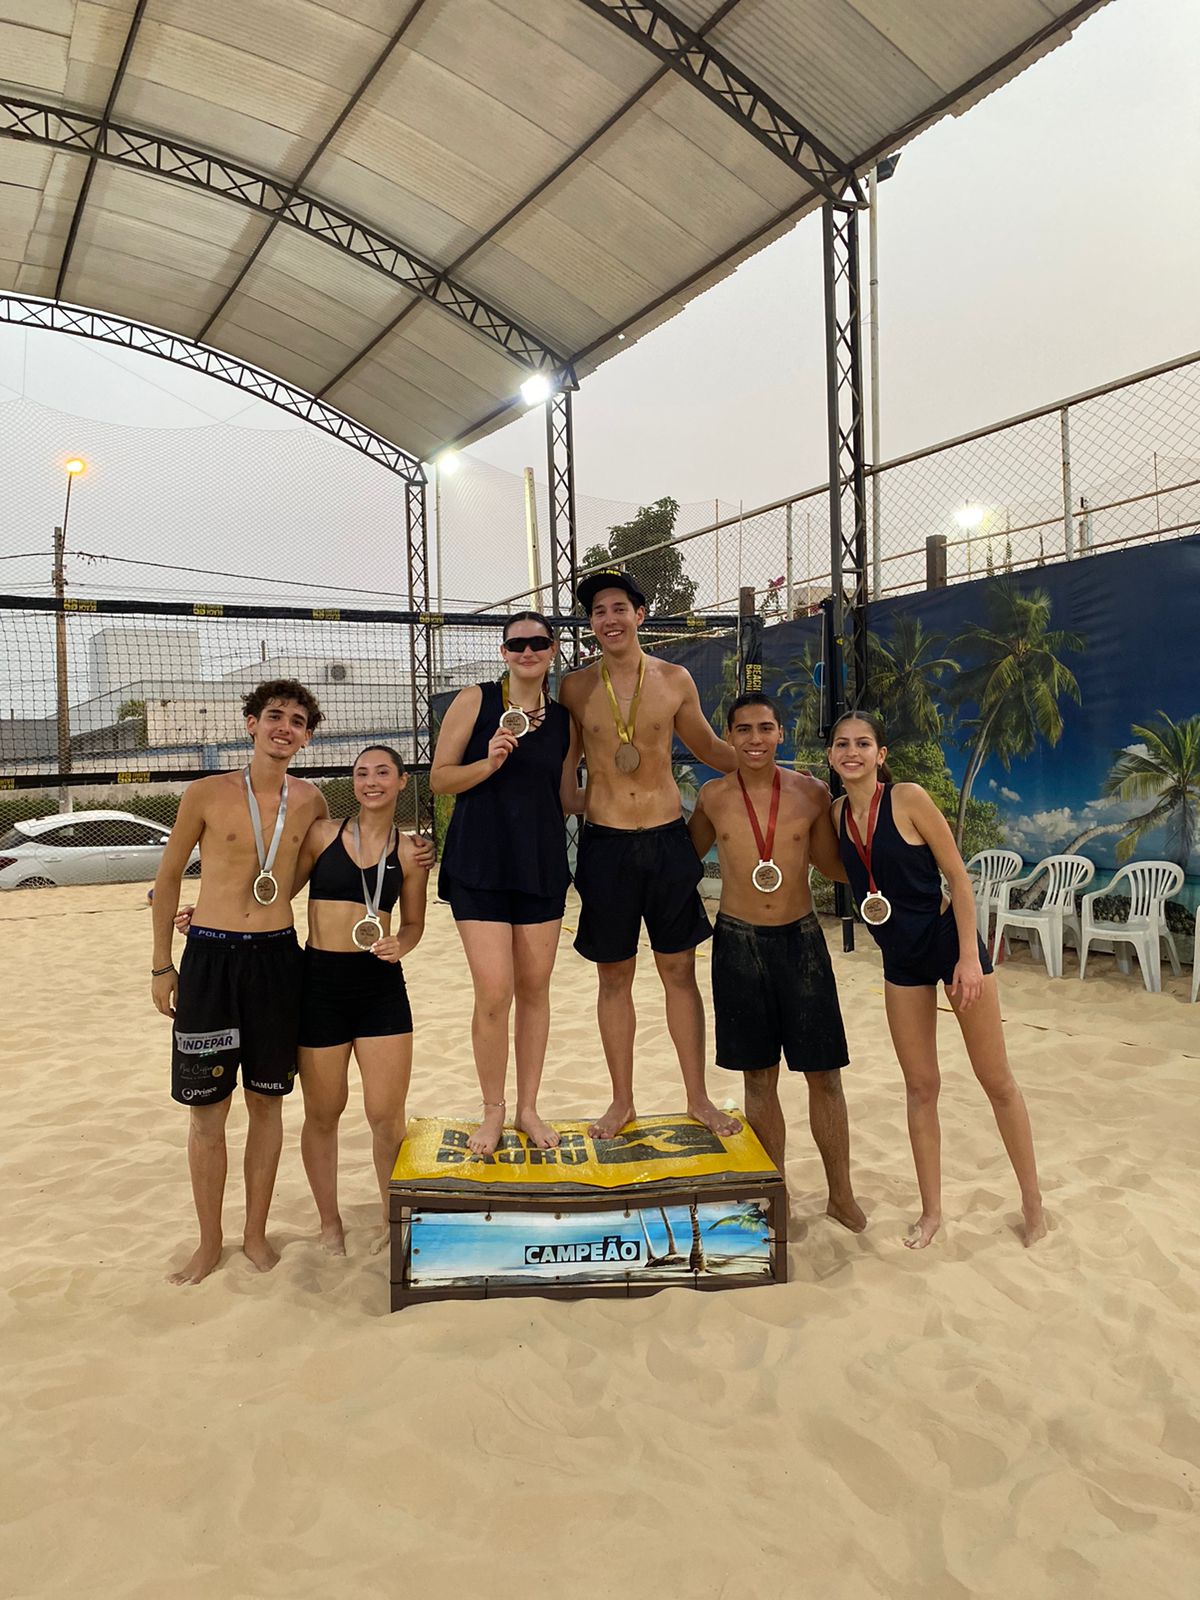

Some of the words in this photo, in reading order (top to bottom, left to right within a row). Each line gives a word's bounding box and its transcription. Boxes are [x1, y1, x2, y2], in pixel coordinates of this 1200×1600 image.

[198, 930, 226, 939] POLO
[182, 1035, 233, 1050] INDEPAR
[251, 1080, 285, 1090] SAMUEL
[525, 1237, 638, 1264] CAMPEÃO
